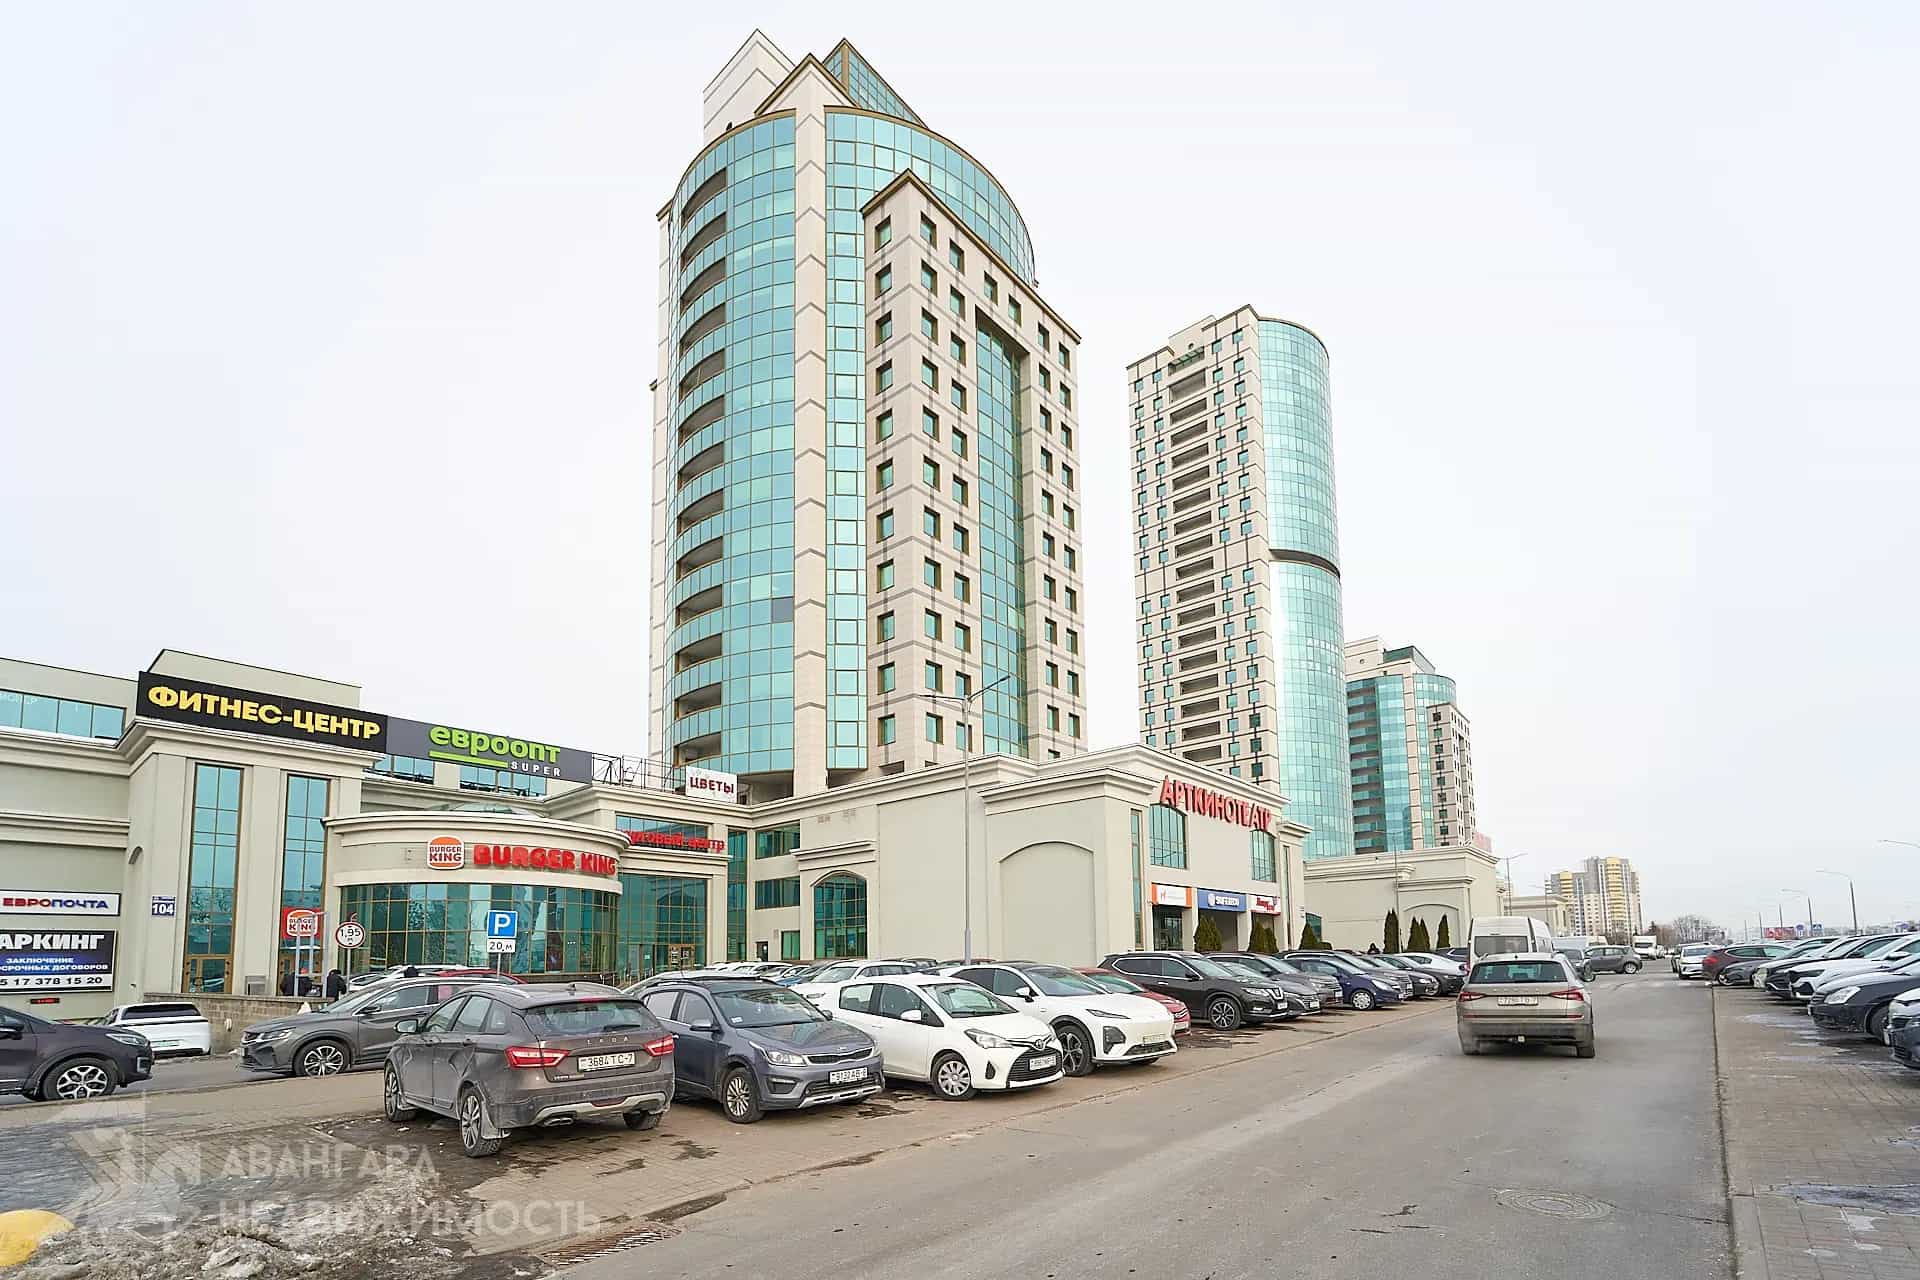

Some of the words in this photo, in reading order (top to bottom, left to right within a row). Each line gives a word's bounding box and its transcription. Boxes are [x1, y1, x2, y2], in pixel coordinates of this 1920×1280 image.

[148, 686, 381, 739] ФИТНЕС-ЦЕНТР
[430, 726, 561, 763] евроопт
[511, 761, 561, 777] SUPER
[689, 776, 734, 794] ЦВЕТЫ
[429, 852, 462, 863] KING
[473, 843, 576, 871] BURGER
[580, 852, 616, 877] KING
[3, 897, 109, 909] ЕВРОПОЧТА
[152, 903, 174, 915] 104
[494, 913, 511, 935] P
[14, 978, 31, 986] 17
[35, 977, 61, 985] 378
[66, 977, 82, 985] 15
[87, 976, 103, 984] 20
